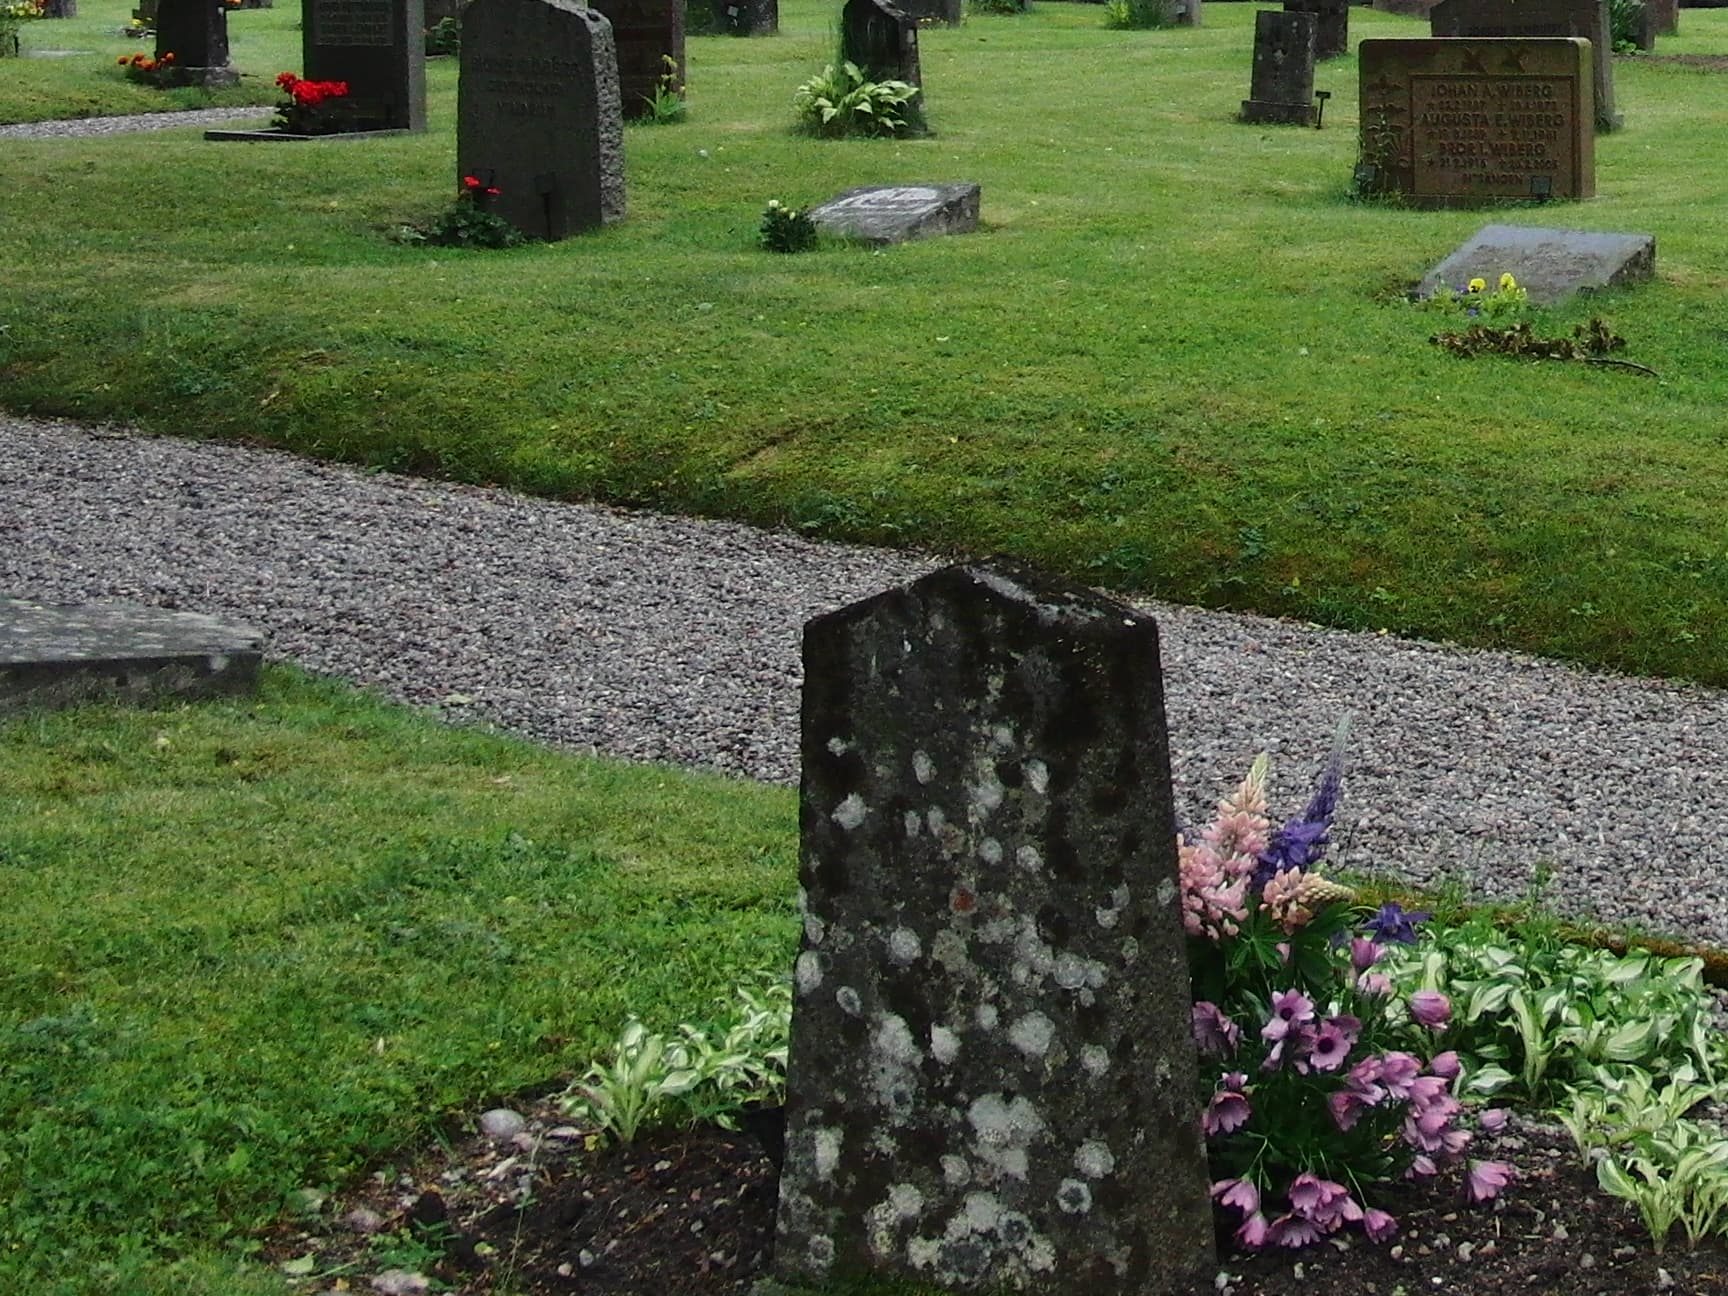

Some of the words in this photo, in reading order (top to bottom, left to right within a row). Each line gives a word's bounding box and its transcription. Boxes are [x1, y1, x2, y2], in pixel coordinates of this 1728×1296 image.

[1496, 83, 1553, 97] WIBERG
[1420, 112, 1491, 128] AUGUSTA
[1508, 113, 1565, 127] WIBERG
[1489, 142, 1545, 156] WIBERG
